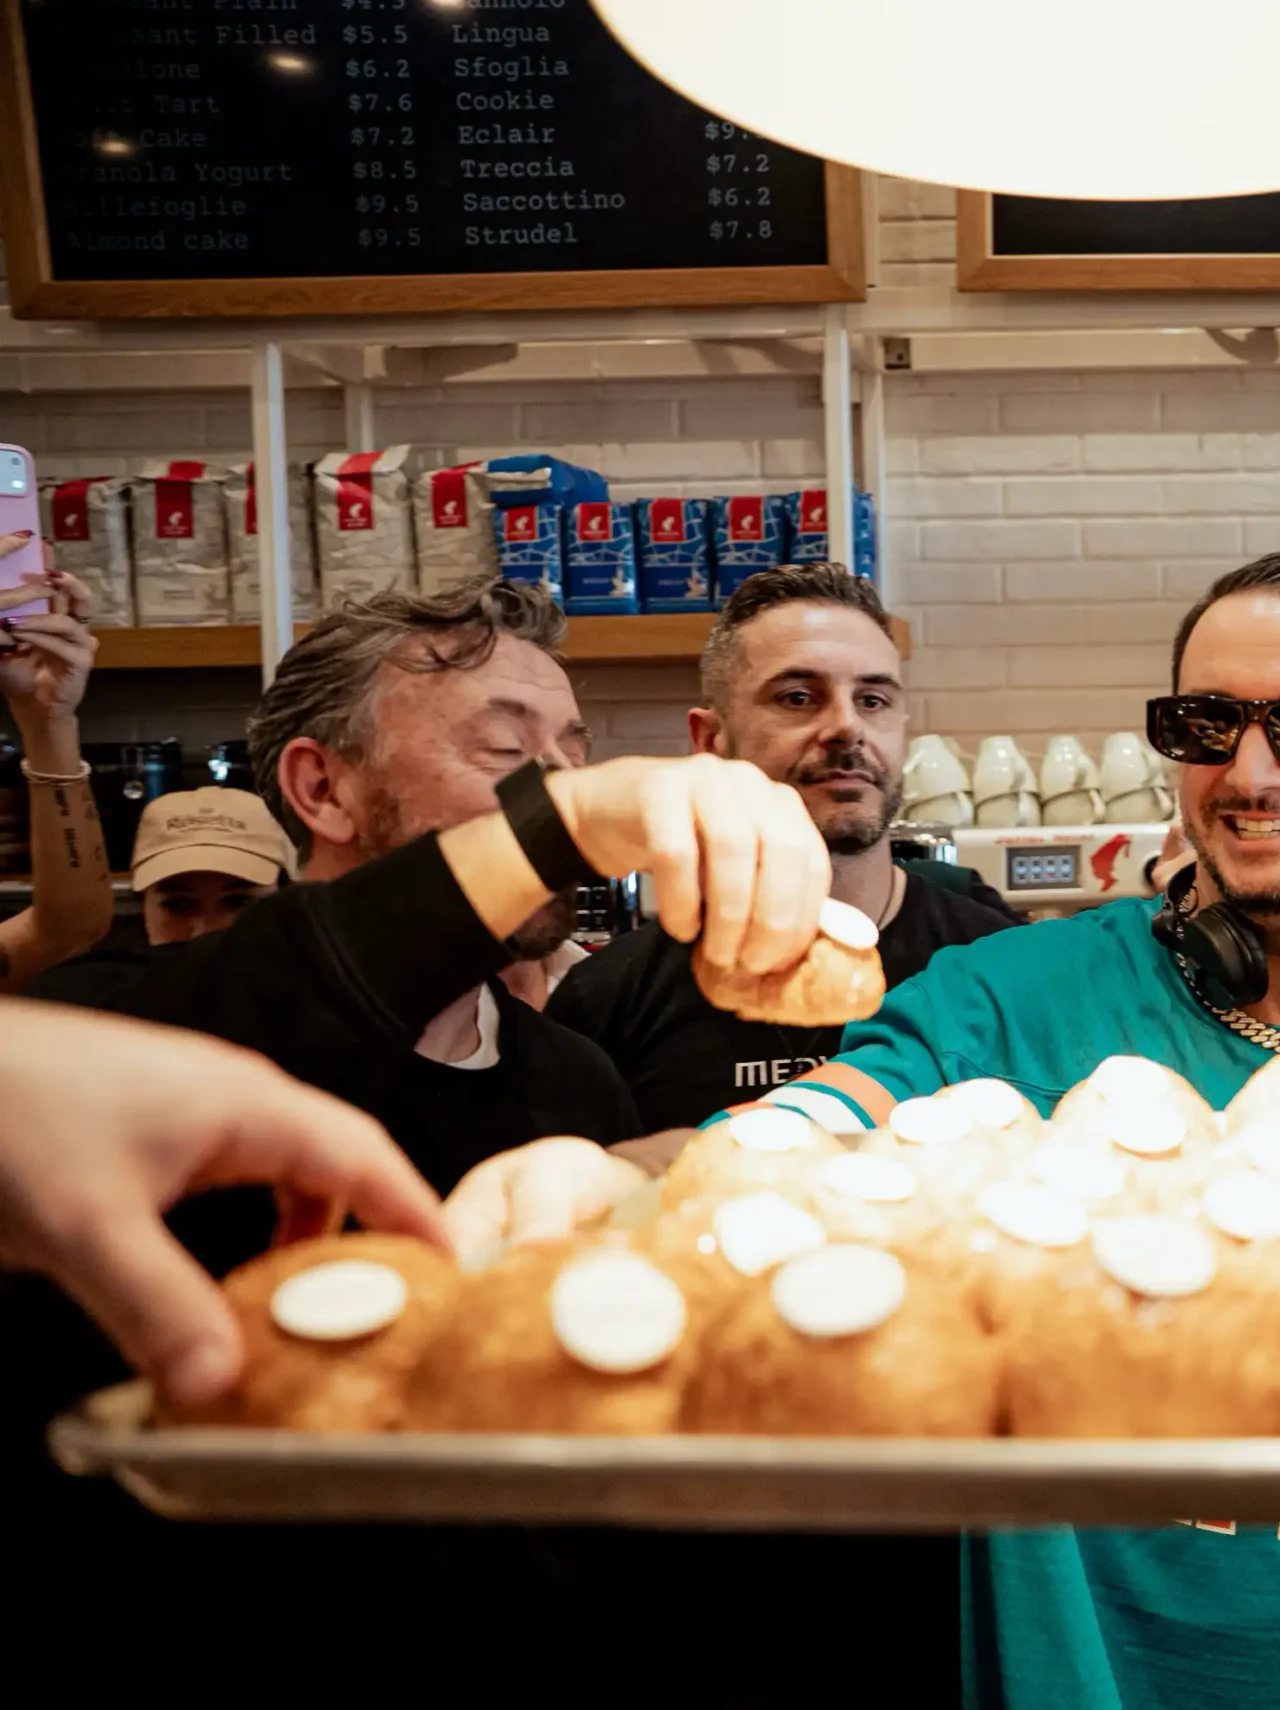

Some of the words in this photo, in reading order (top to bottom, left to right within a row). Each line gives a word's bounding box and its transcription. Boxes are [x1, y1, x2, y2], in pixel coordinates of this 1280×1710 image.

[215, 23, 317, 45] Filled
[342, 25, 408, 45] $5.5
[451, 22, 551, 48] Lingua
[345, 57, 411, 79] $6.2
[453, 55, 570, 82] Sfoglia
[153, 94, 221, 114] Tart
[348, 93, 413, 114] $7.6
[455, 89, 555, 112] Cookie
[139, 126, 208, 148] Cake
[350, 126, 415, 147] $7.2
[458, 123, 556, 145] Eclair
[704, 120, 762, 141] $9.
[64, 161, 176, 182] ranola
[193, 161, 293, 187] Yogurt
[352, 161, 417, 181] $8.5
[460, 156, 576, 178] Treccia
[706, 154, 770, 174] $7.2
[354, 194, 420, 216] $9.5
[463, 188, 626, 212] Saccottino
[707, 187, 772, 208] $6.2
[183, 229, 250, 251] cake
[356, 227, 422, 249] $9.5
[465, 222, 579, 246] Strudel
[709, 220, 774, 240] $7.8
